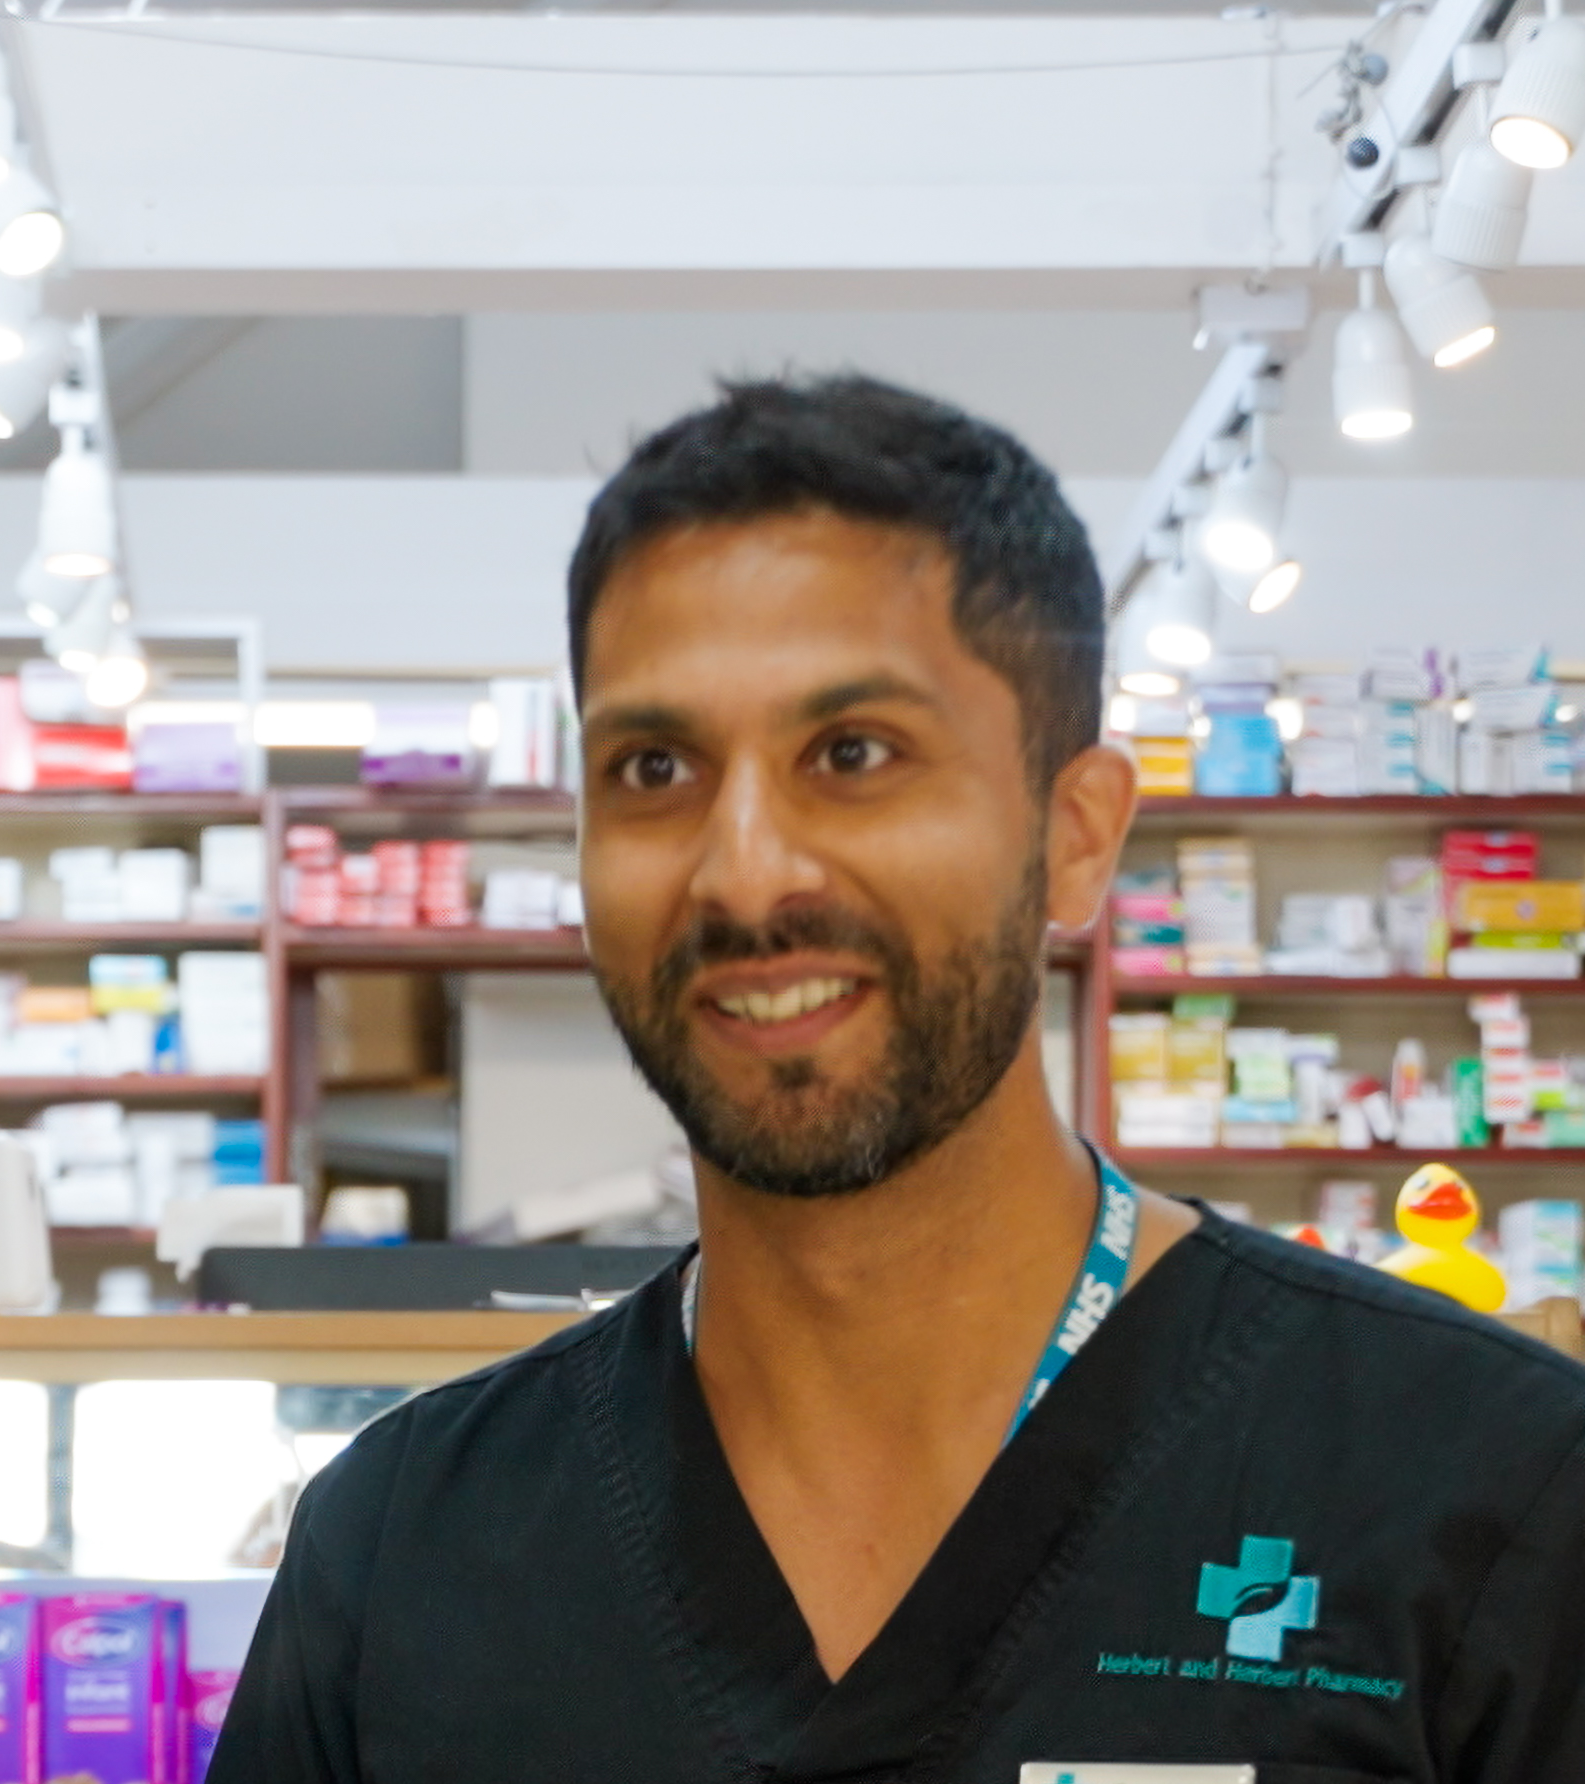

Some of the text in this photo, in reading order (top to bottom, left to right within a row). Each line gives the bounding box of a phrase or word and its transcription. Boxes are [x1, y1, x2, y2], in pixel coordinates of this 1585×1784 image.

[1057, 1272, 1115, 1356] NHS
[1178, 1657, 1219, 1680] and
[1305, 1665, 1408, 1702] Pharmacy
